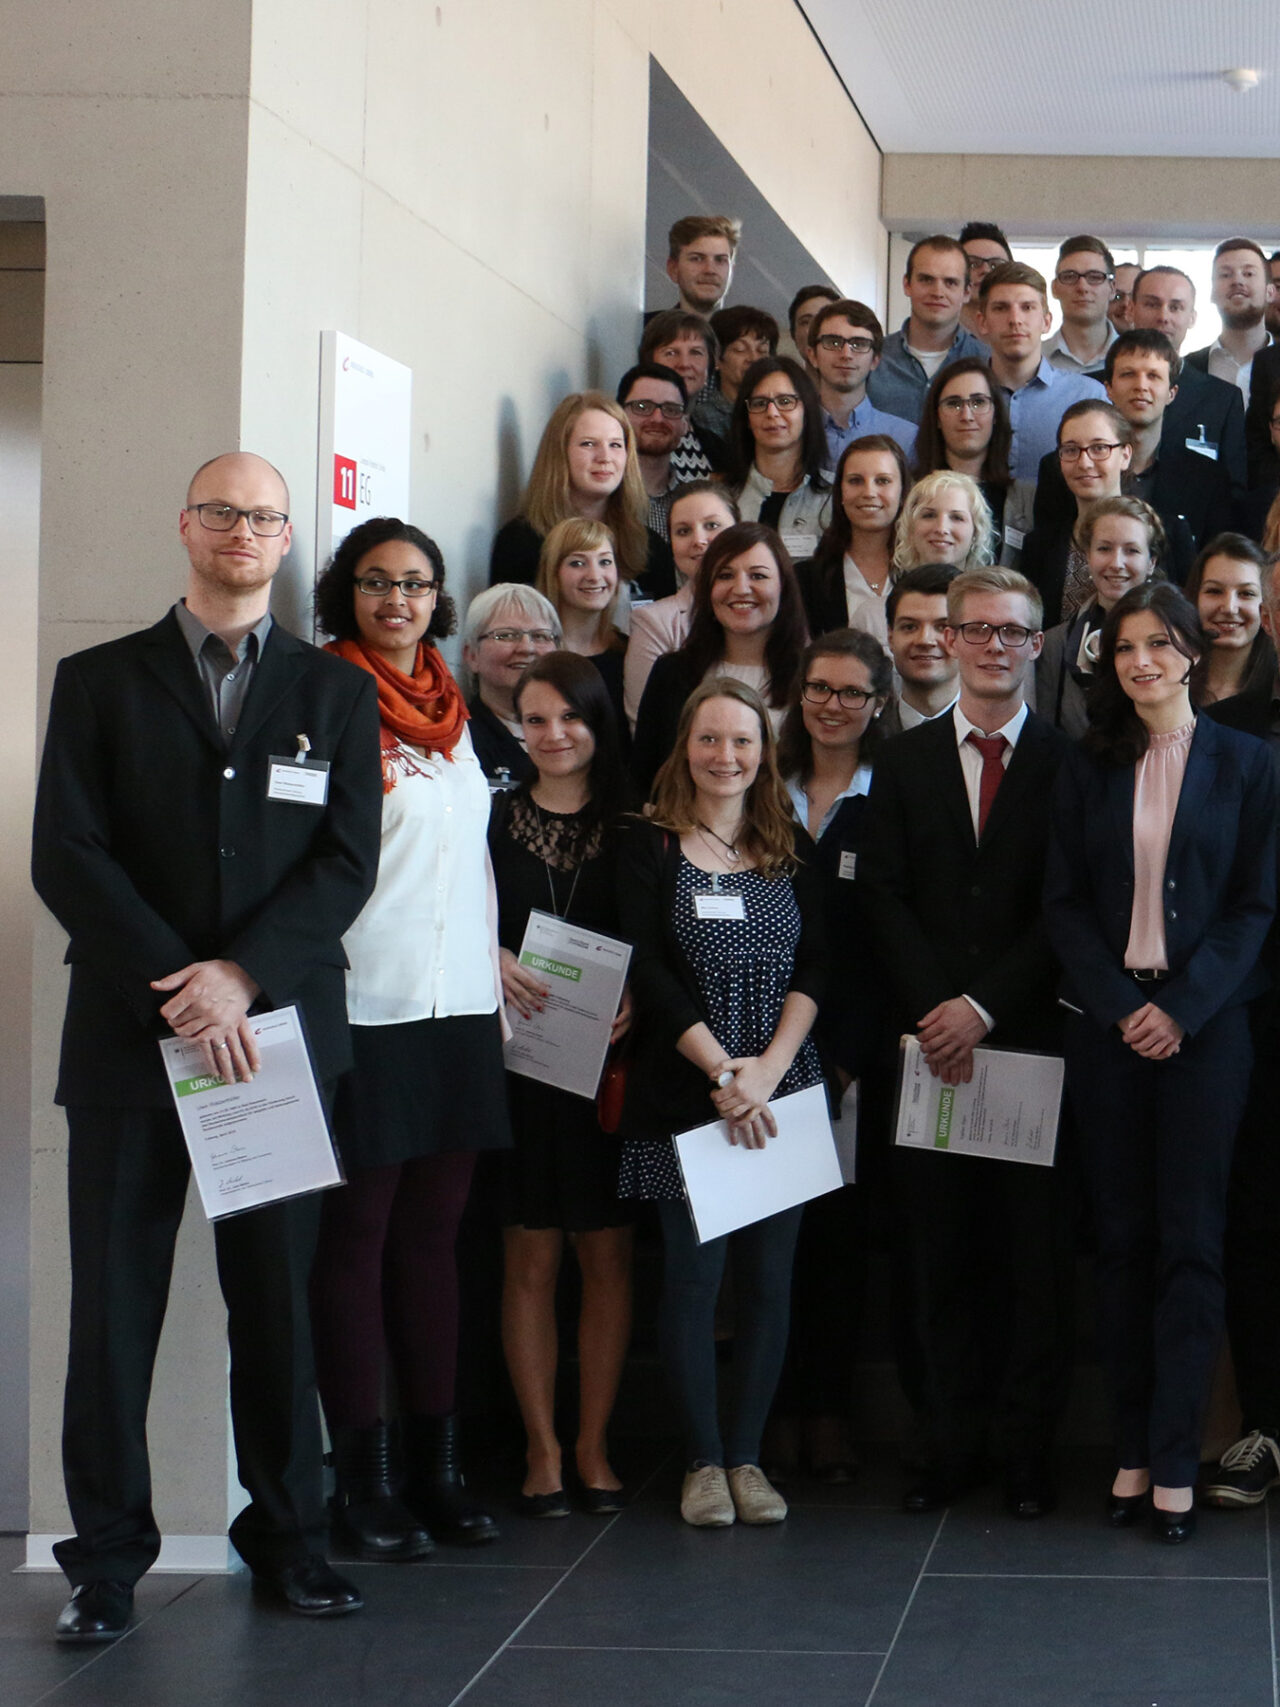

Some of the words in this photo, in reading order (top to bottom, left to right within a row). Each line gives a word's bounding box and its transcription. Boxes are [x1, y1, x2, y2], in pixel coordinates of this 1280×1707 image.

[341, 466, 354, 500] 11
[360, 473, 371, 506] EG
[532, 956, 578, 979] URKUNDE
[939, 1091, 952, 1137] URKUNDE
